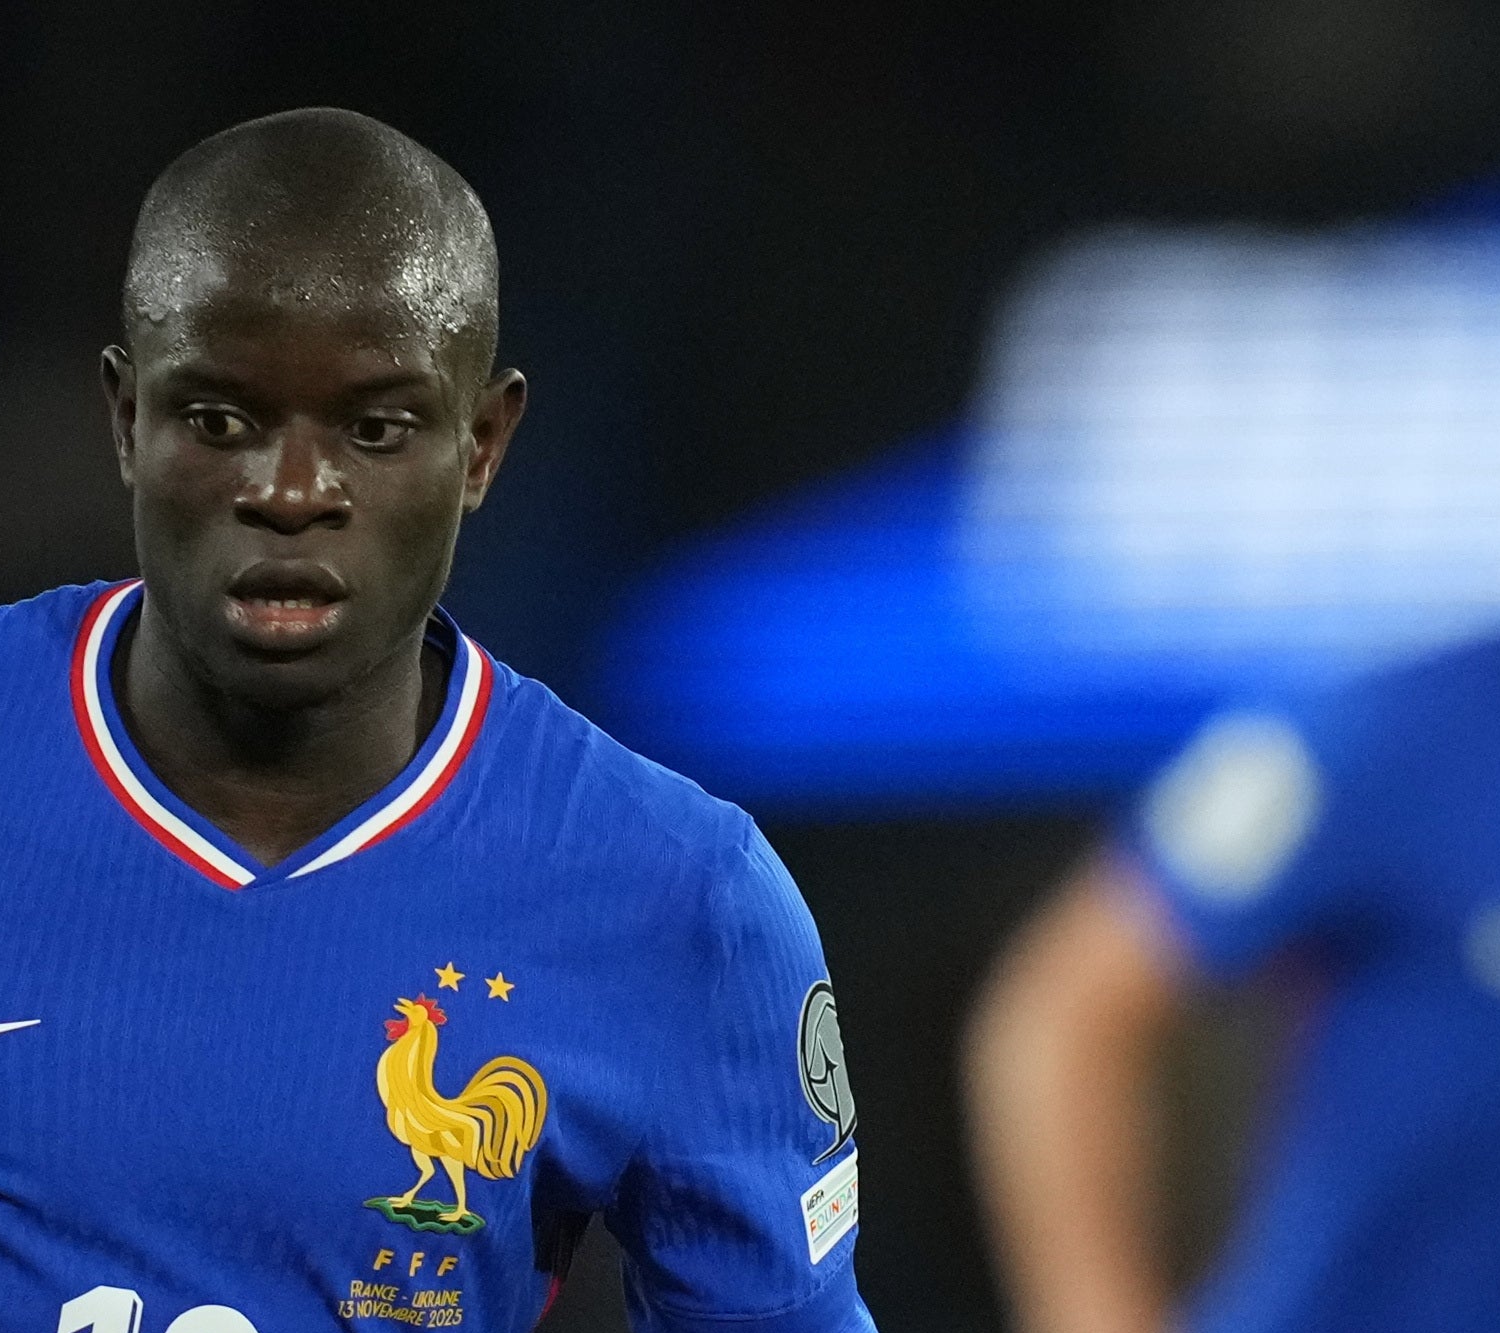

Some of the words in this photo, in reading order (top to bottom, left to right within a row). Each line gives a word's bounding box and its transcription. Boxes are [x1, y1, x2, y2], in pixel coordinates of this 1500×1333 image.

[350, 1280, 400, 1301] FRANCE
[412, 1290, 463, 1308] UKRAINE
[338, 1300, 355, 1319] 13
[357, 1300, 426, 1326] NOVEMBRE
[427, 1309, 463, 1328] 2025
